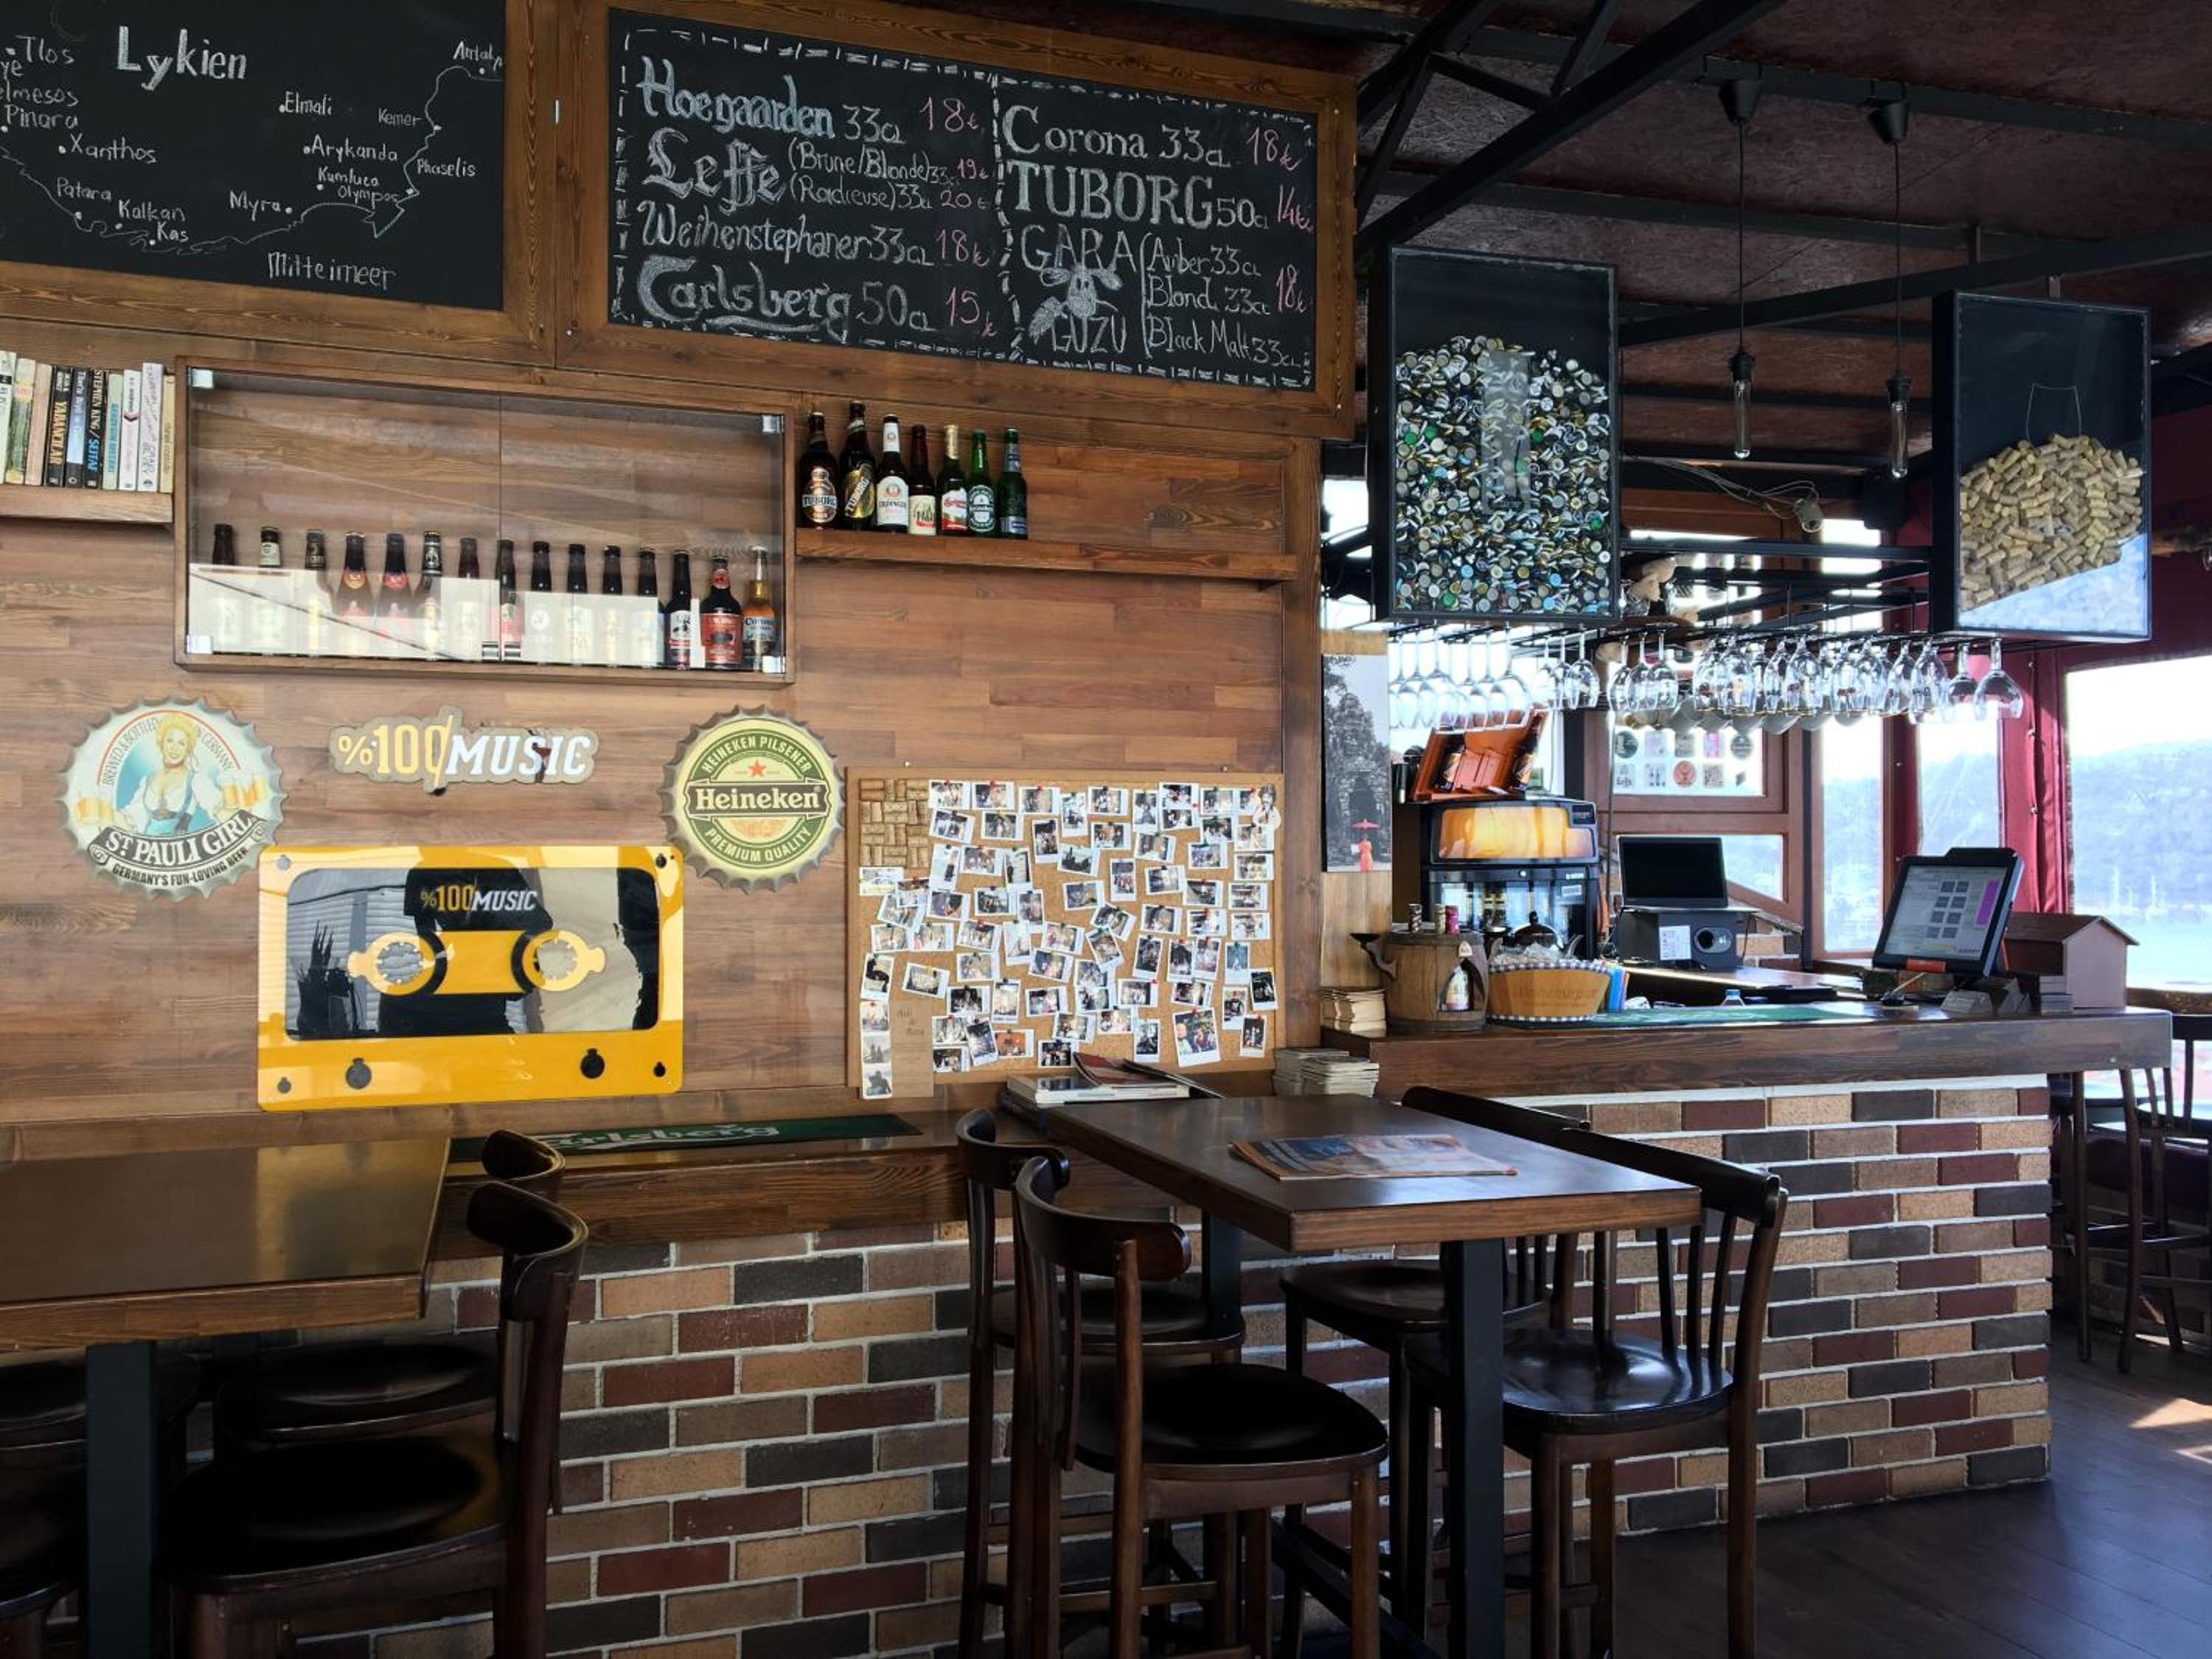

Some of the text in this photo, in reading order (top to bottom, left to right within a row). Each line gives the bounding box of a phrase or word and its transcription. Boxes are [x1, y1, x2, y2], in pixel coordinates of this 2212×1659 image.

[15, 35, 74, 64] Tlos
[116, 25, 248, 91] Lykien
[285, 90, 333, 116] Elmali
[636, 55, 836, 139] Hoegaarden
[4, 104, 80, 130] Pinara
[378, 107, 422, 127] Kemer
[1002, 104, 1149, 159] Corona
[70, 134, 157, 164] Xanthos
[312, 133, 398, 163] Arykanda
[318, 165, 379, 187] Kumluca
[417, 156, 476, 178] Phaselis
[641, 126, 787, 216] Leffe
[56, 178, 111, 202] Patara
[337, 184, 400, 210] Olympos
[1006, 159, 1214, 229] TUBORG
[118, 199, 186, 222] Kalkan
[229, 191, 281, 220] Myra
[156, 222, 189, 243] Kas
[636, 200, 870, 265] Weihenstephaner
[1020, 223, 1137, 272] GARA
[636, 254, 853, 345] Carlsberg
[445, 734, 593, 775] MUSIC
[701, 735, 813, 774] HEINEKEN PILSENER
[695, 787, 820, 810] Heineken
[132, 838, 201, 866] PAULI
[201, 813, 252, 858] GIRL
[705, 827, 762, 862] PREMIUM
[764, 827, 812, 862] QUALITY
[112, 863, 170, 886] GERMANY'S
[170, 860, 228, 886] FUN-LOVING
[470, 889, 538, 912] MUSIC
